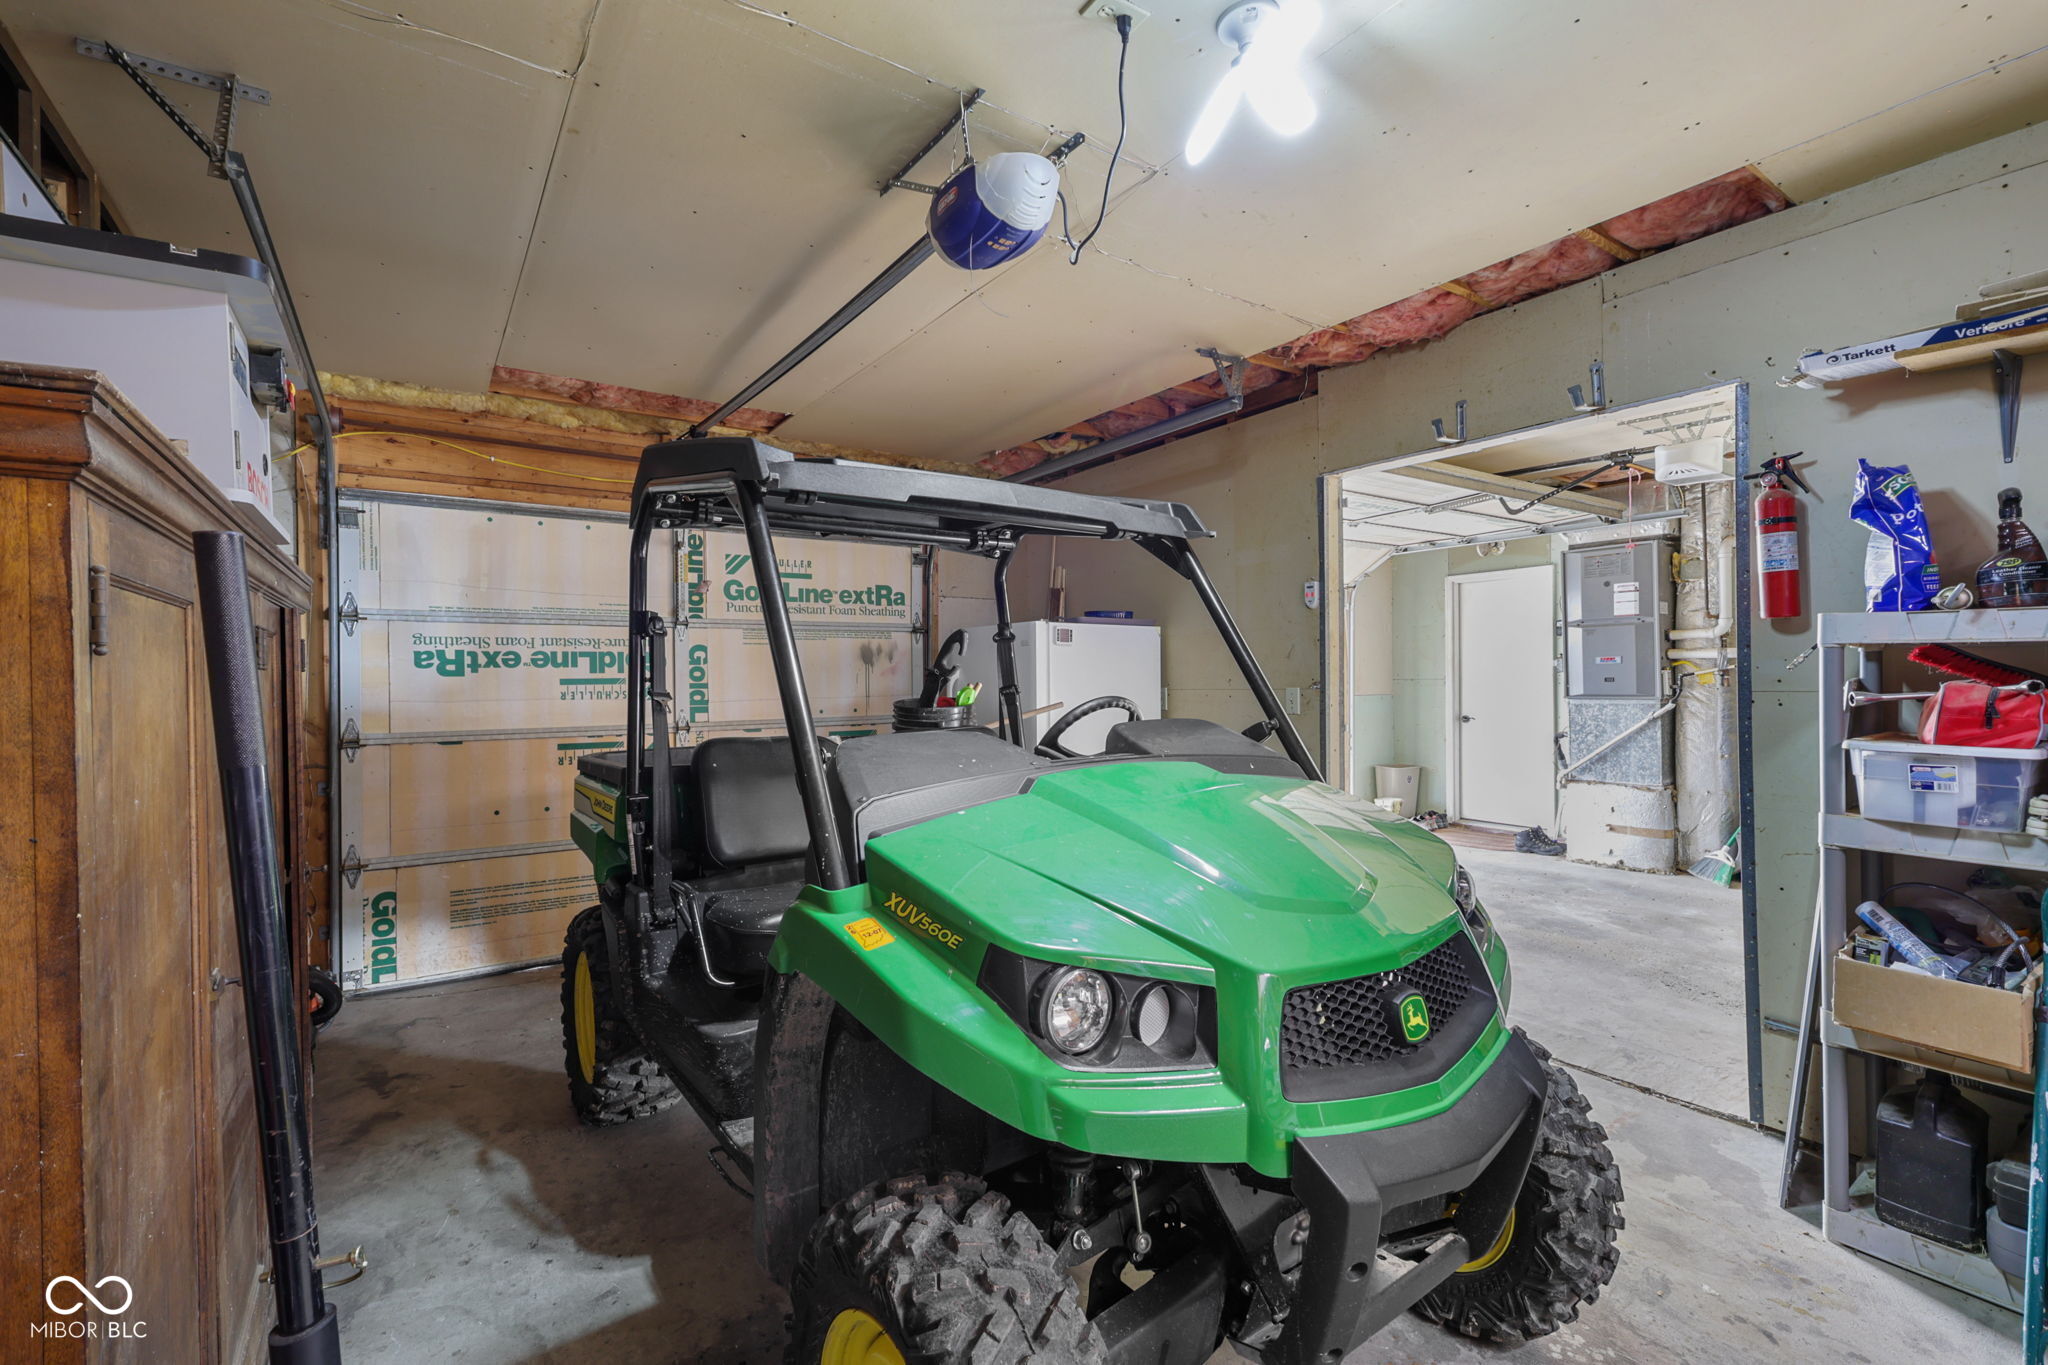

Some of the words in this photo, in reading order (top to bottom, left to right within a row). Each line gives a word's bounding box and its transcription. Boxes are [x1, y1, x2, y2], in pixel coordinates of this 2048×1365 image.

[1841, 343, 1897, 361] Tarkett
[779, 559, 813, 569] ULLER
[723, 579, 834, 603] GoLine
[838, 585, 906, 607] extRa
[829, 605, 857, 616] Foam
[858, 606, 906, 619] Sheathing
[412, 633, 491, 649] Sheathing
[495, 636, 535, 649] Foam
[413, 649, 522, 677] extRa
[559, 689, 628, 700] SCHULLER
[884, 892, 964, 950] XUV560E
